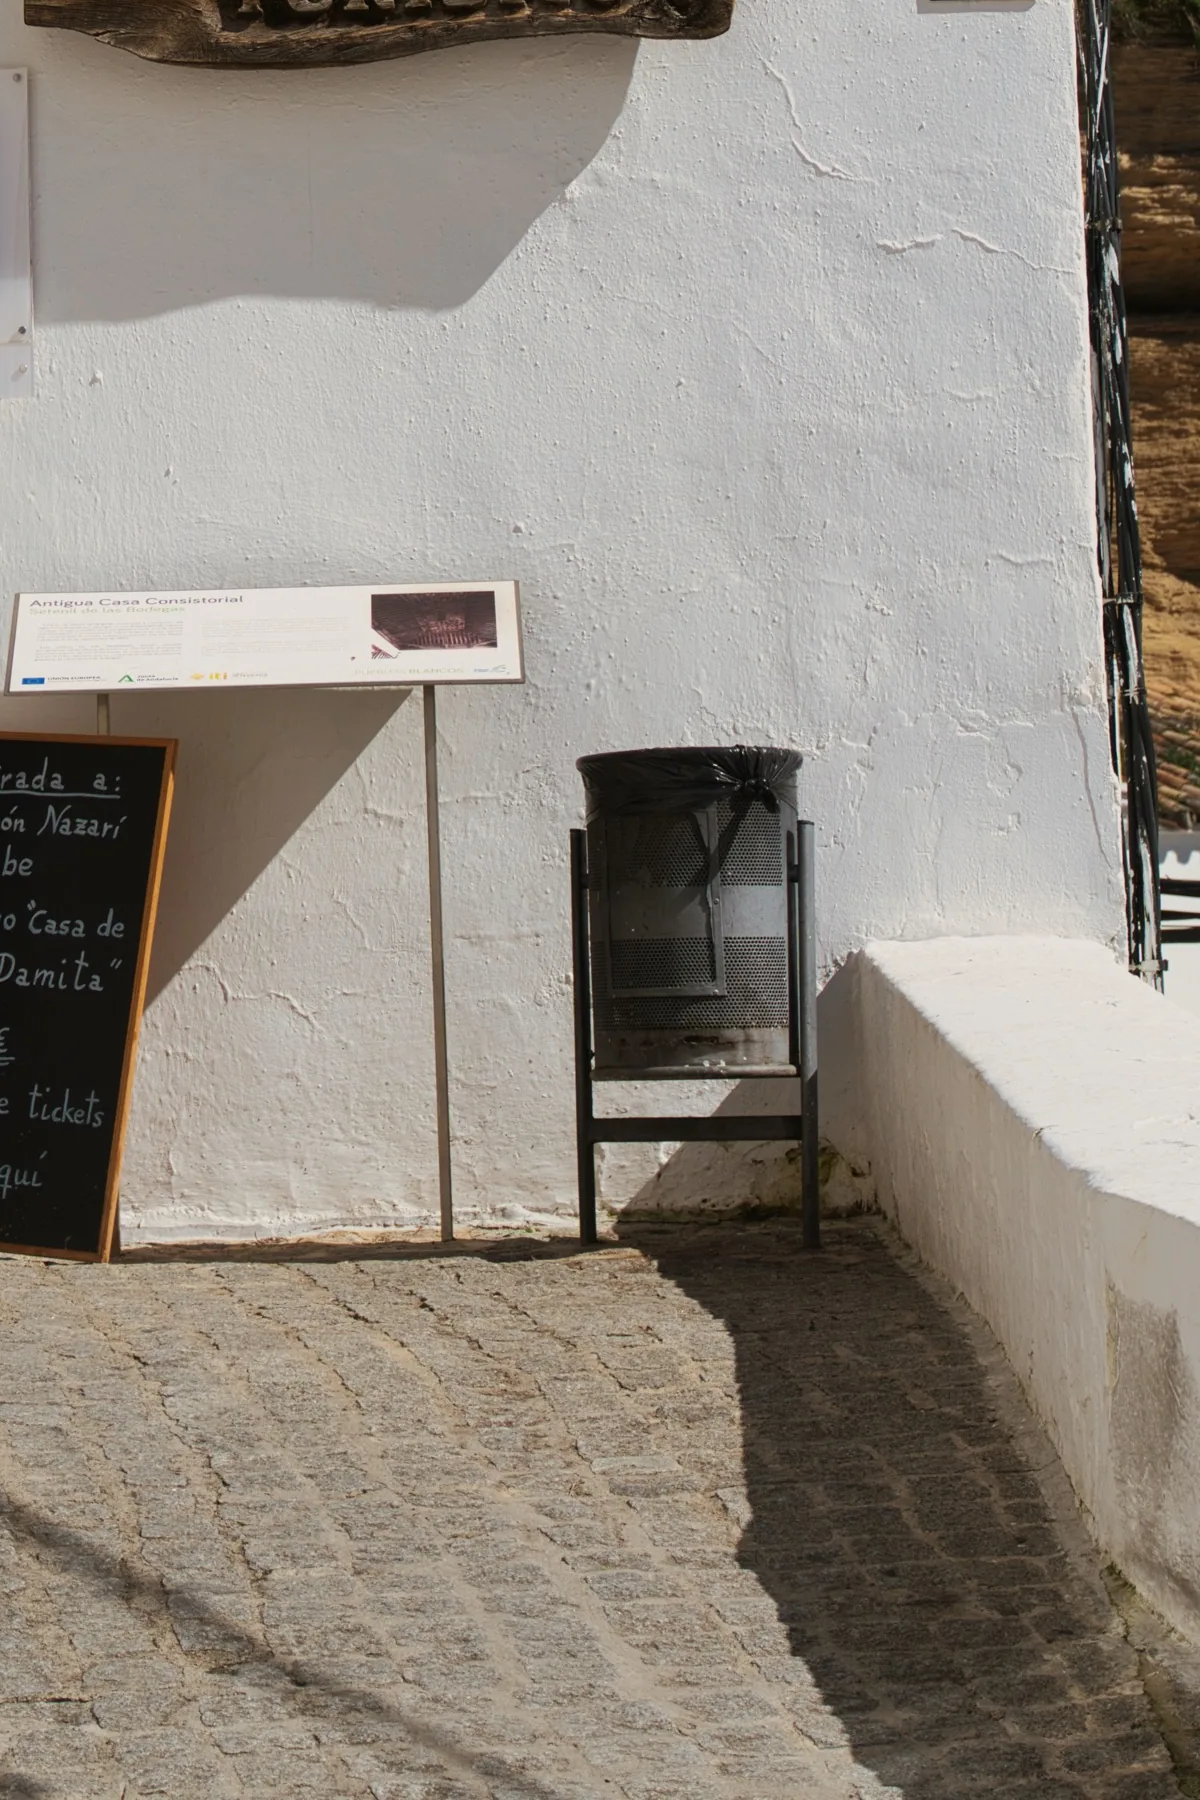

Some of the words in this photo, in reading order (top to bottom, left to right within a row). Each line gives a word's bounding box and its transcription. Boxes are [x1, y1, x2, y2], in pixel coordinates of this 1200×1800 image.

[29, 599, 93, 608] Antigua
[99, 598, 140, 606] Casa
[145, 595, 244, 605] Consistorial
[92, 773, 121, 792] a:
[37, 804, 127, 839] Nazarí
[97, 908, 125, 938] de
[28, 1083, 105, 1128] tickets
